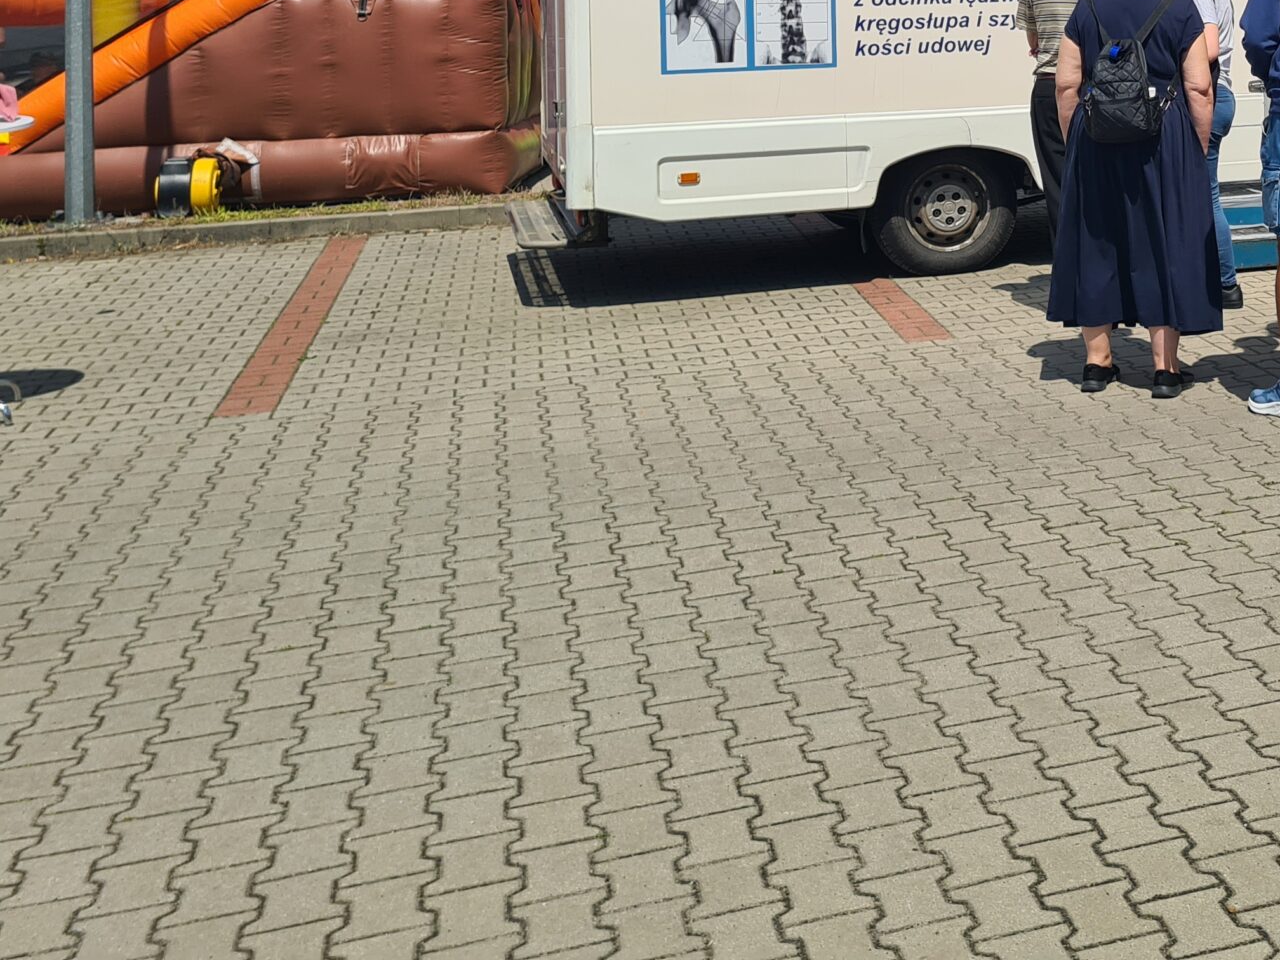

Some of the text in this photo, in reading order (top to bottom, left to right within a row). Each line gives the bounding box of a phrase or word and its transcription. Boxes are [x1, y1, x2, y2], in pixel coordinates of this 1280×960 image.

[854, 13, 970, 36] kręgosłupa
[976, 11, 983, 28] i
[854, 35, 992, 57] kości udowej
